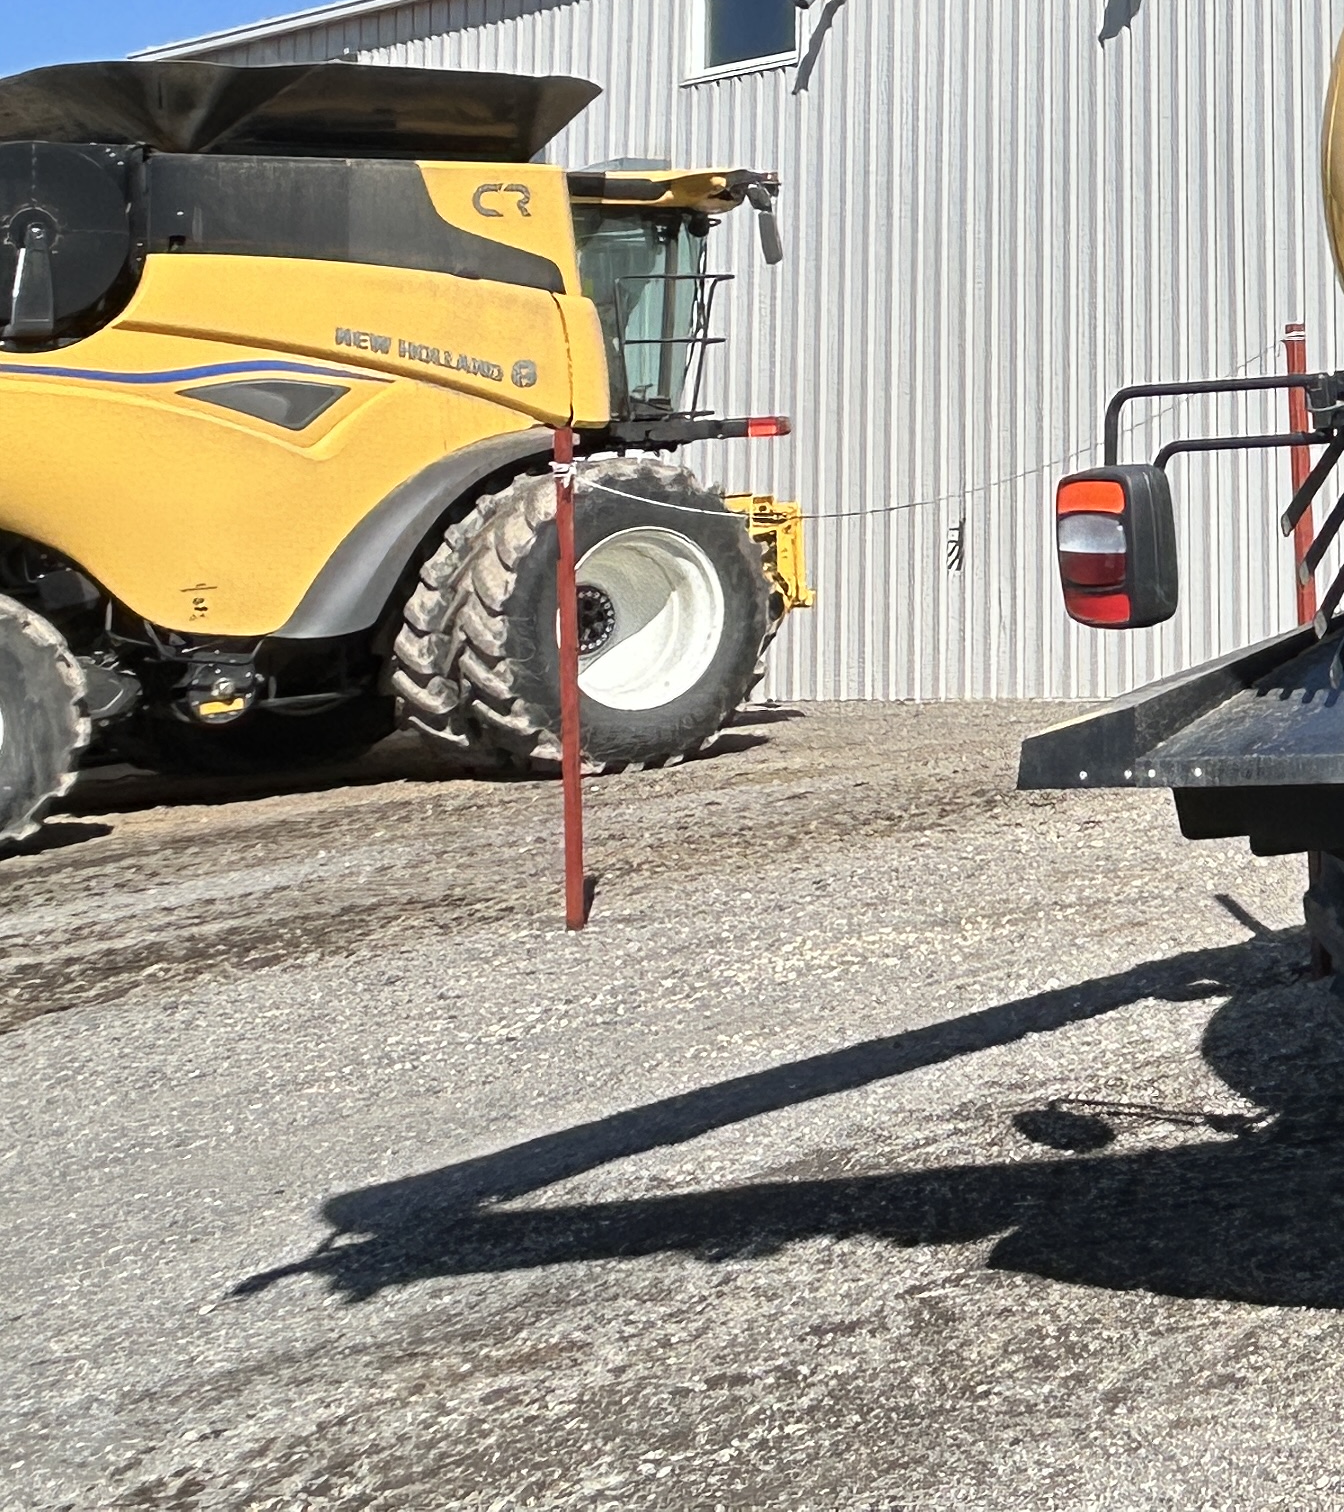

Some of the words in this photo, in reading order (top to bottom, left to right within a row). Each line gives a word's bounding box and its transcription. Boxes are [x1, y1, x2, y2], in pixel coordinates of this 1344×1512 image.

[472, 183, 531, 217] CR
[335, 327, 391, 354] NEW
[398, 338, 504, 382] HOLLAND
